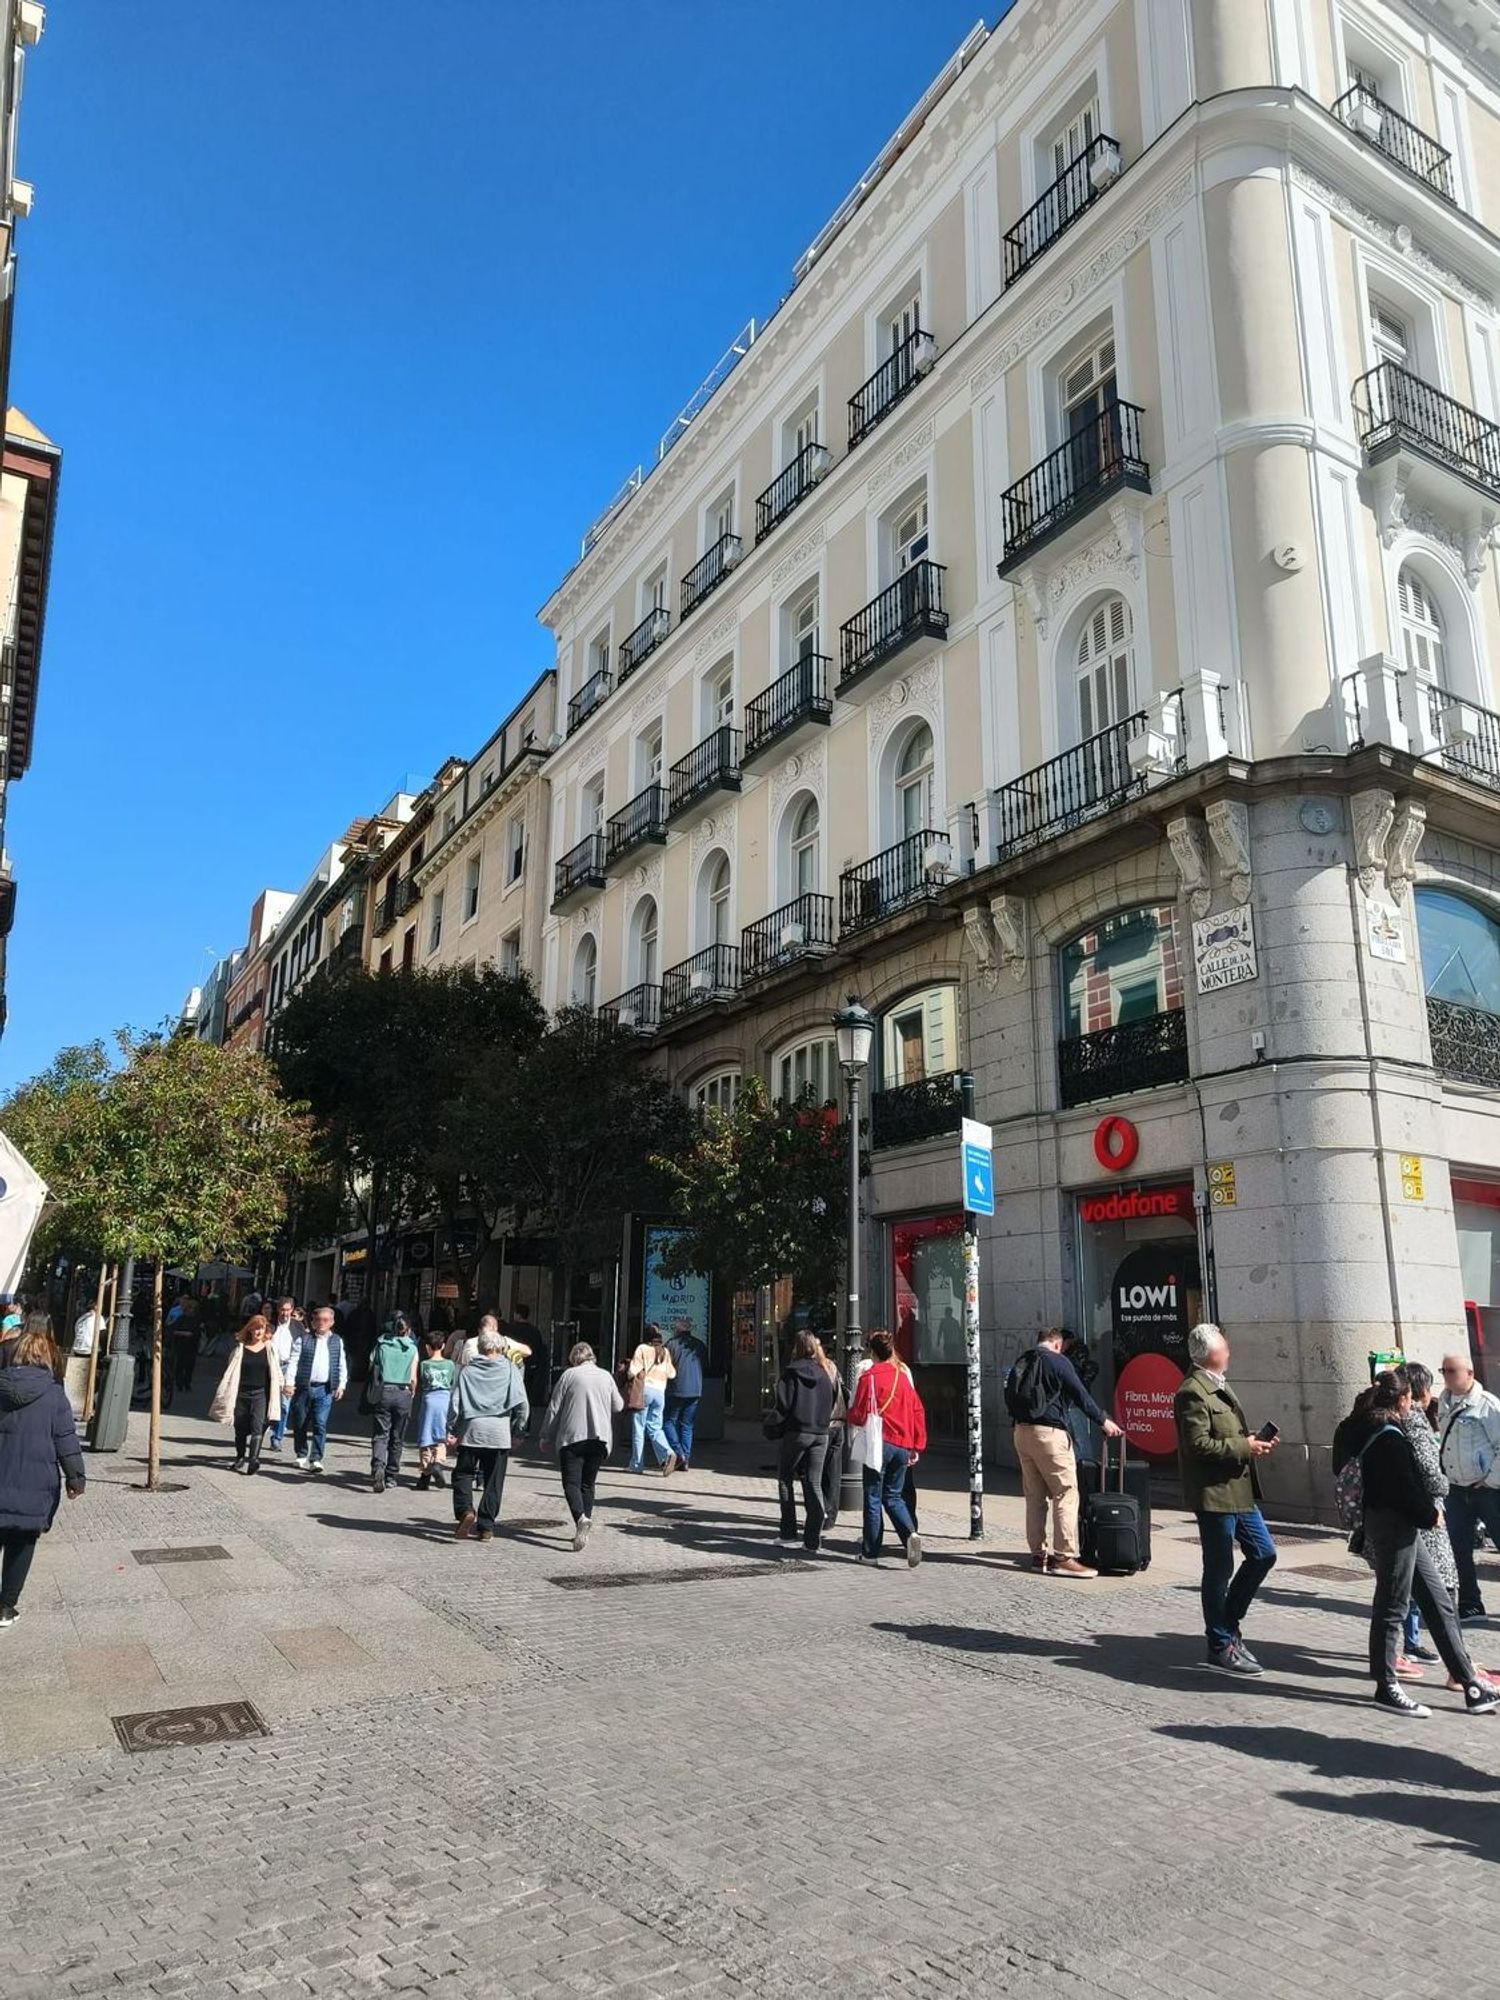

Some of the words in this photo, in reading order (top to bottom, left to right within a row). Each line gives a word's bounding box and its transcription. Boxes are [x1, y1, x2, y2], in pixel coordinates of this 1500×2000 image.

[1200, 957, 1228, 975] CALLE
[1230, 957, 1239, 965] DE
[1241, 953, 1250, 961] LA
[1201, 963, 1254, 989] MONTERA
[1082, 1190, 1177, 1221] vodafone
[662, 1293, 695, 1304] MADRID
[1152, 1313, 1161, 1321] de
[1125, 1391, 1150, 1403] Fibra,
[1126, 1408, 1131, 1419] y
[1133, 1408, 1145, 1417] un
[1146, 1407, 1174, 1419] servic
[1127, 1420, 1154, 1432] único.
